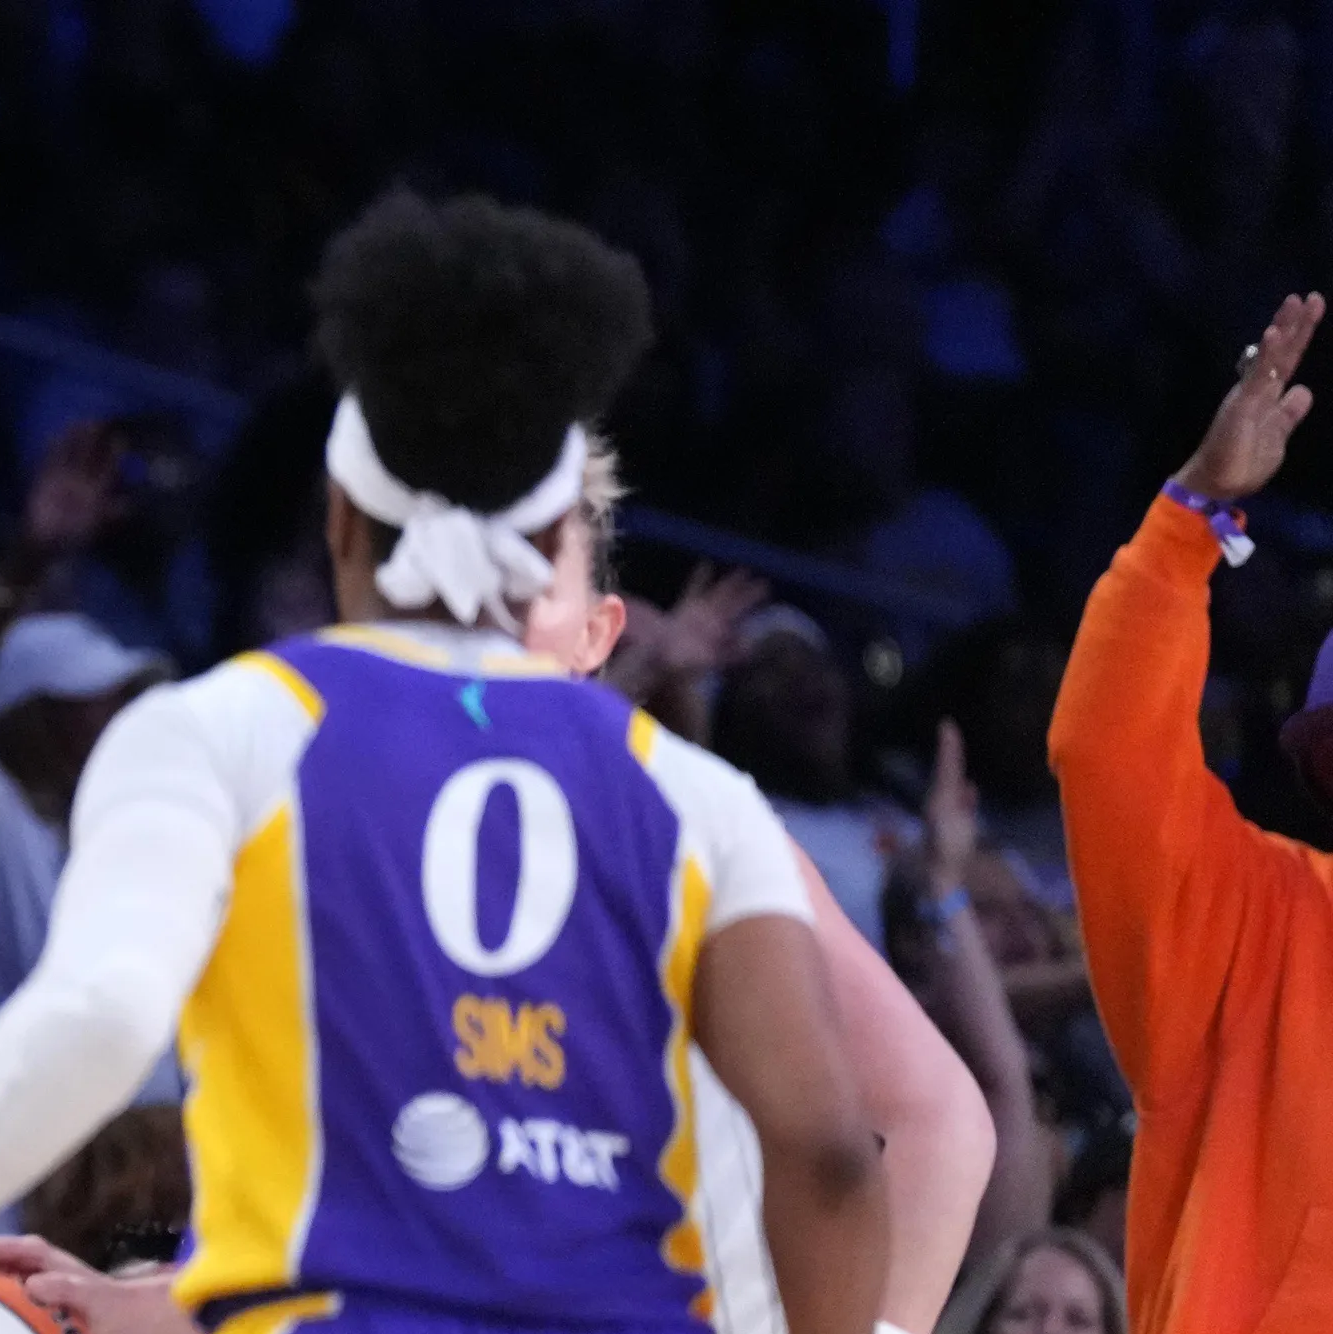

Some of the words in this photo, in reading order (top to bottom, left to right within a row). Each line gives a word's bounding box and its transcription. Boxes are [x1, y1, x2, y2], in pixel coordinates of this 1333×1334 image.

[421, 756, 579, 978] 0
[452, 993, 567, 1091] SIMS
[497, 1115, 630, 1192] AT&T
